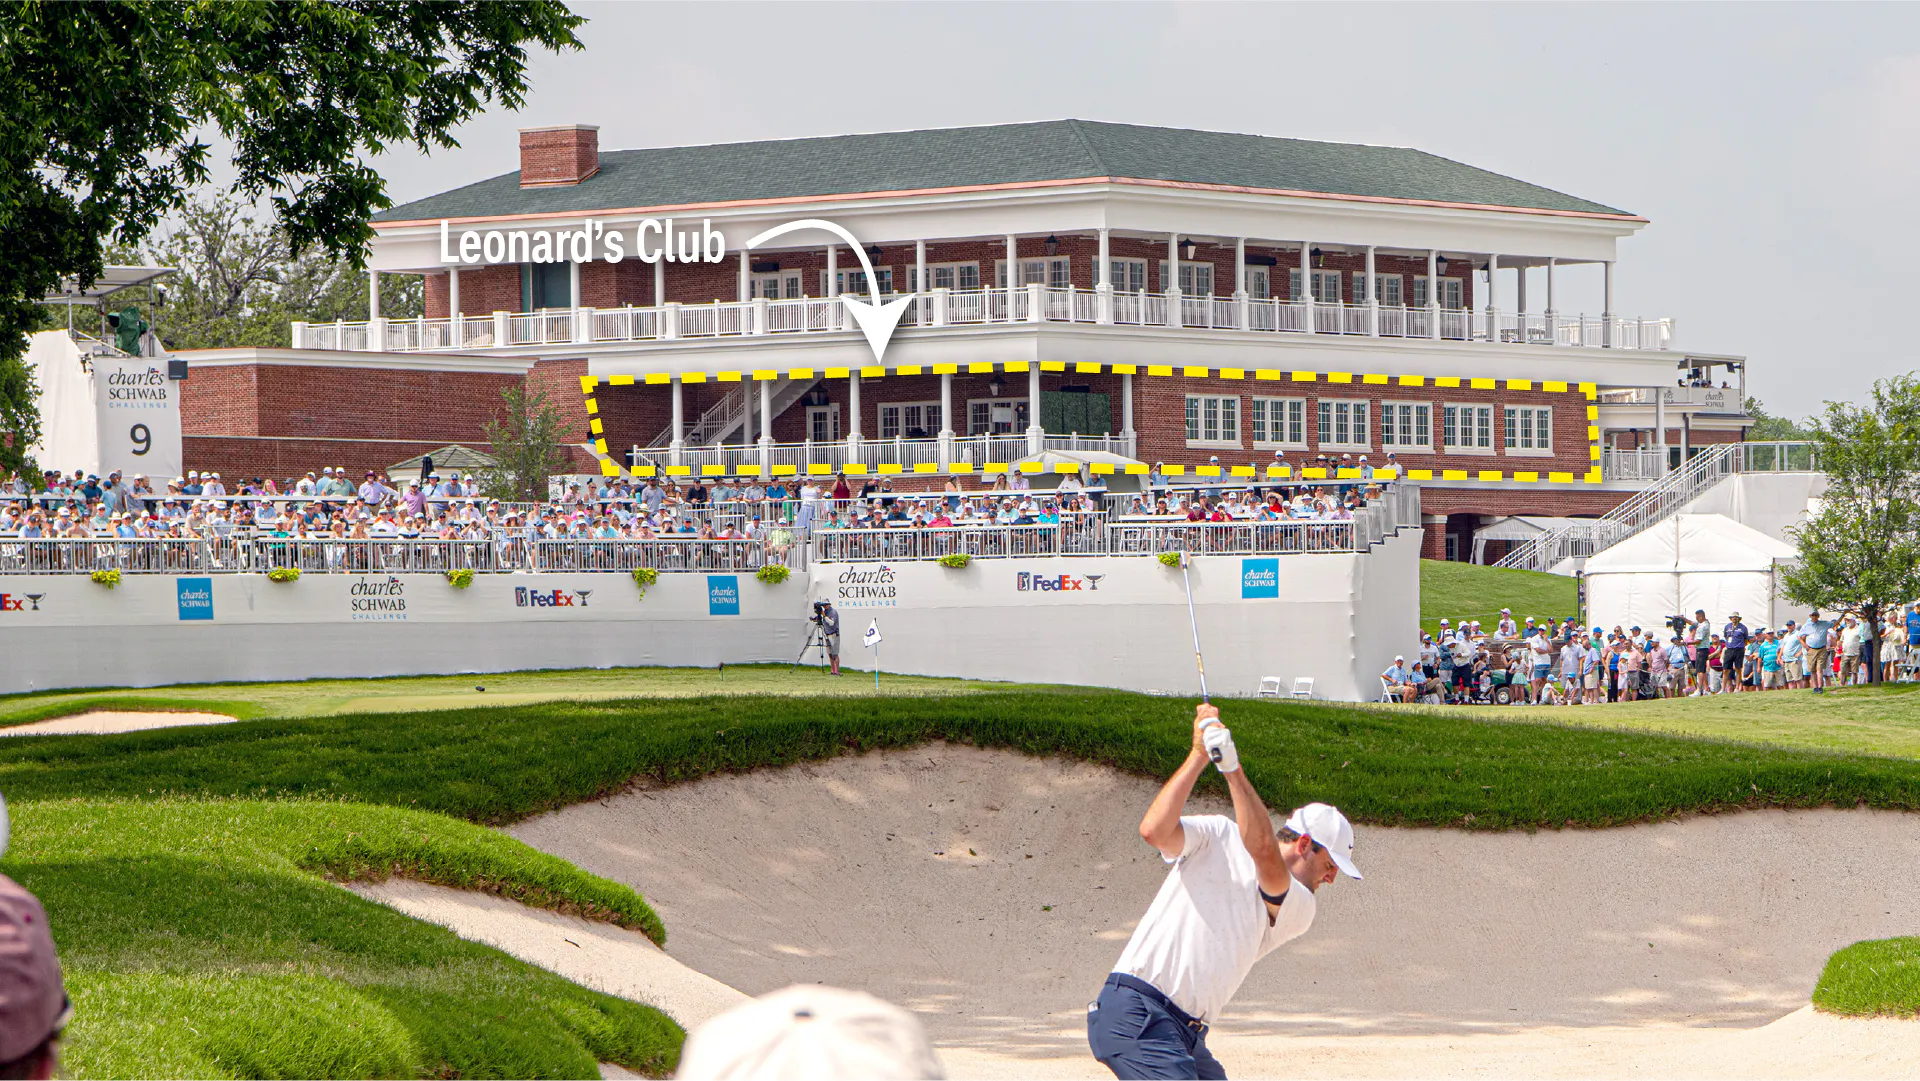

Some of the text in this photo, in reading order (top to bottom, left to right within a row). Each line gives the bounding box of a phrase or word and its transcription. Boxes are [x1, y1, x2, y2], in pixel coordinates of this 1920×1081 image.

[108, 366, 165, 385] charles
[108, 388, 167, 400] SCHWAB
[130, 423, 151, 456] 9
[838, 564, 896, 584] charles
[1033, 574, 1083, 592] FedEx
[1244, 568, 1276, 580] charles
[350, 575, 405, 596] charles
[838, 586, 896, 599] SCHWAB
[0, 593, 24, 611] Ex
[351, 598, 407, 611] SCHWAB
[530, 589, 575, 607] FedEx
